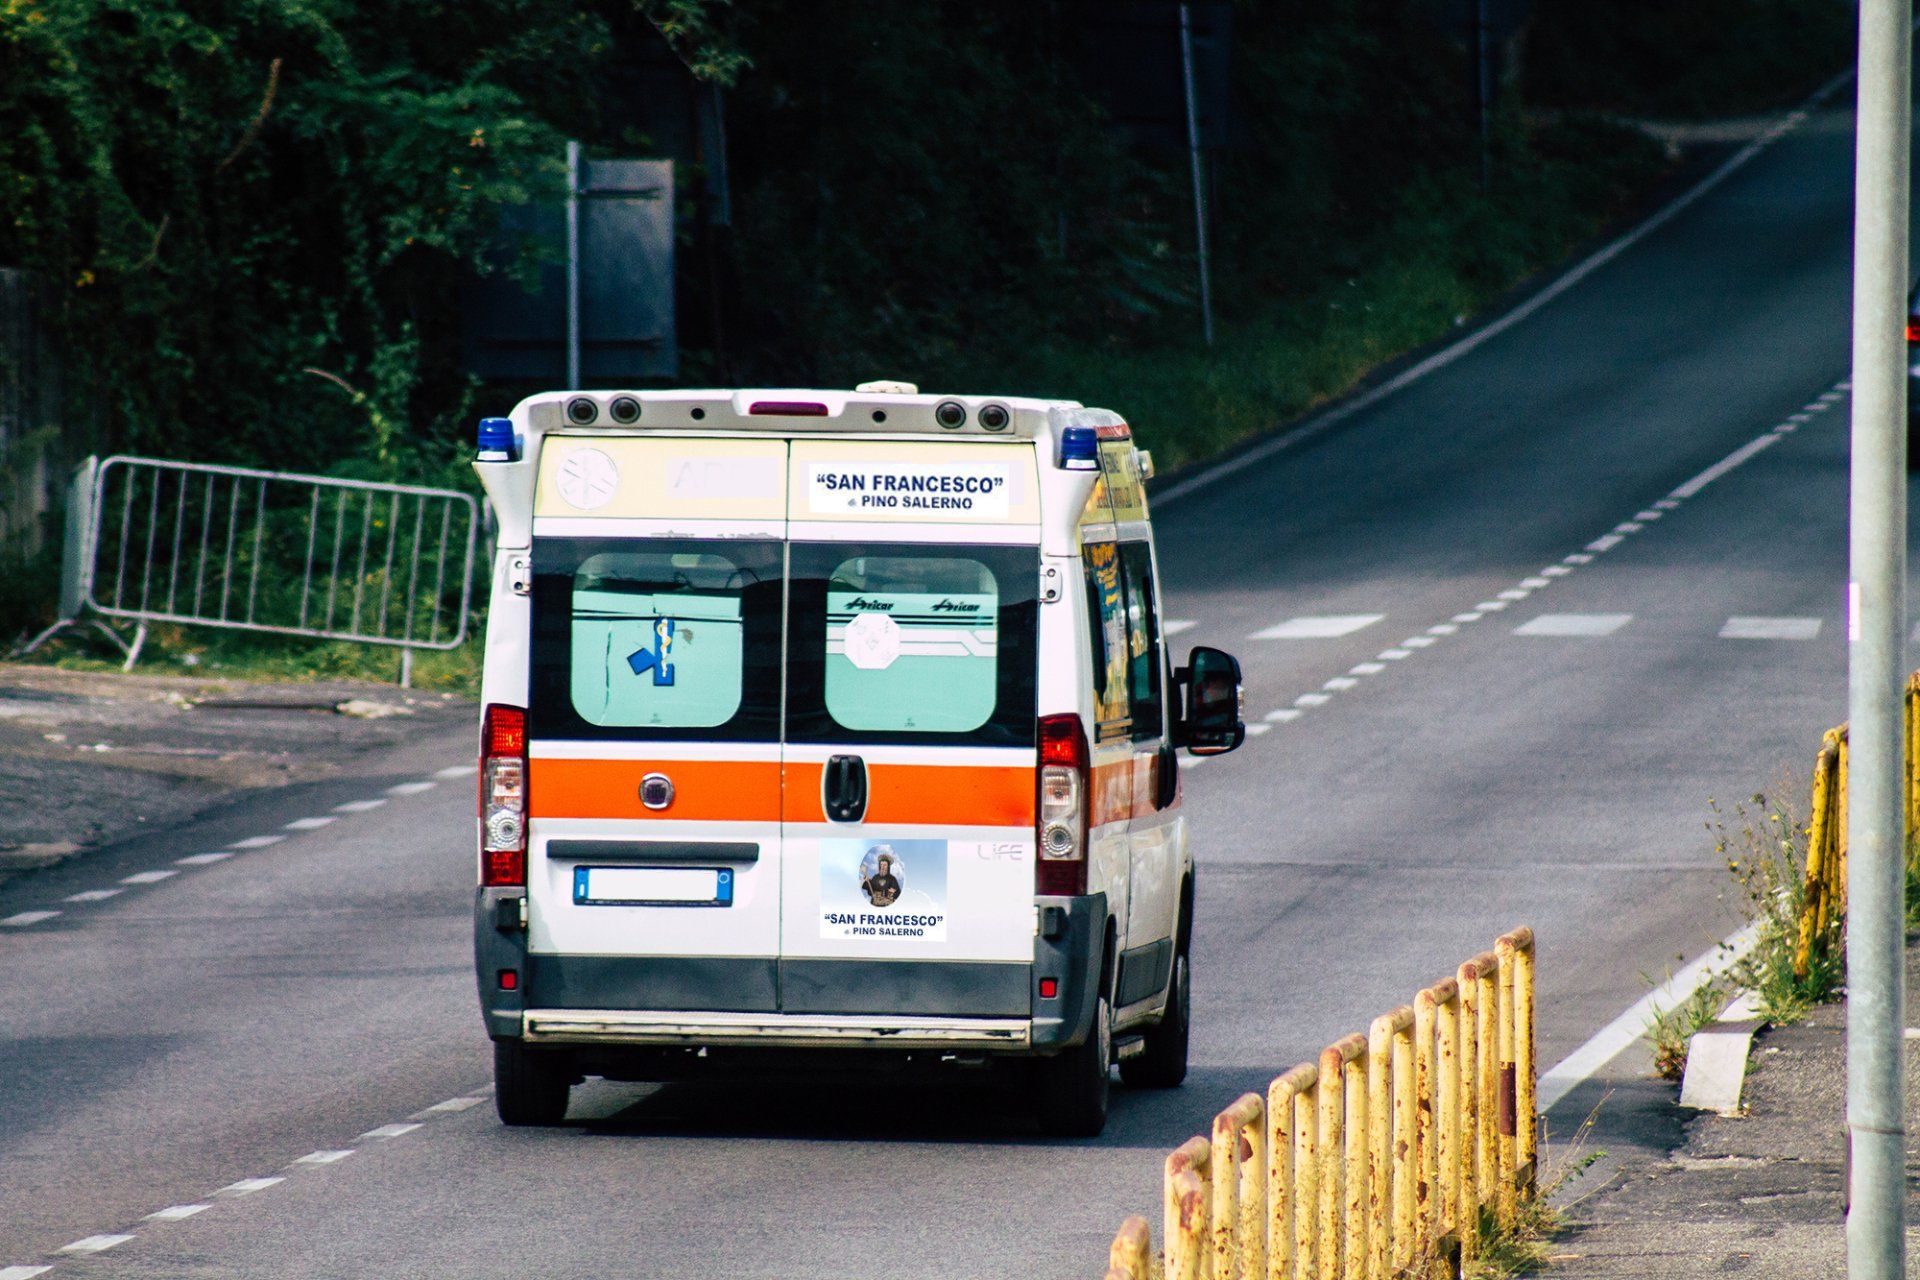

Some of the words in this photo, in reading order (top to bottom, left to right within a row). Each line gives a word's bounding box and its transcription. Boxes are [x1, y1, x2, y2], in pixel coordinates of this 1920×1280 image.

[816, 473, 865, 490] “SAN
[872, 475, 1004, 493] FRANCESCO”
[861, 495, 898, 507] PINO
[902, 496, 973, 509] SALERNO
[824, 913, 856, 925] “SAN
[859, 914, 944, 927] FRANCESCO”
[852, 927, 876, 936] PINO
[878, 927, 924, 937] SALERNO
